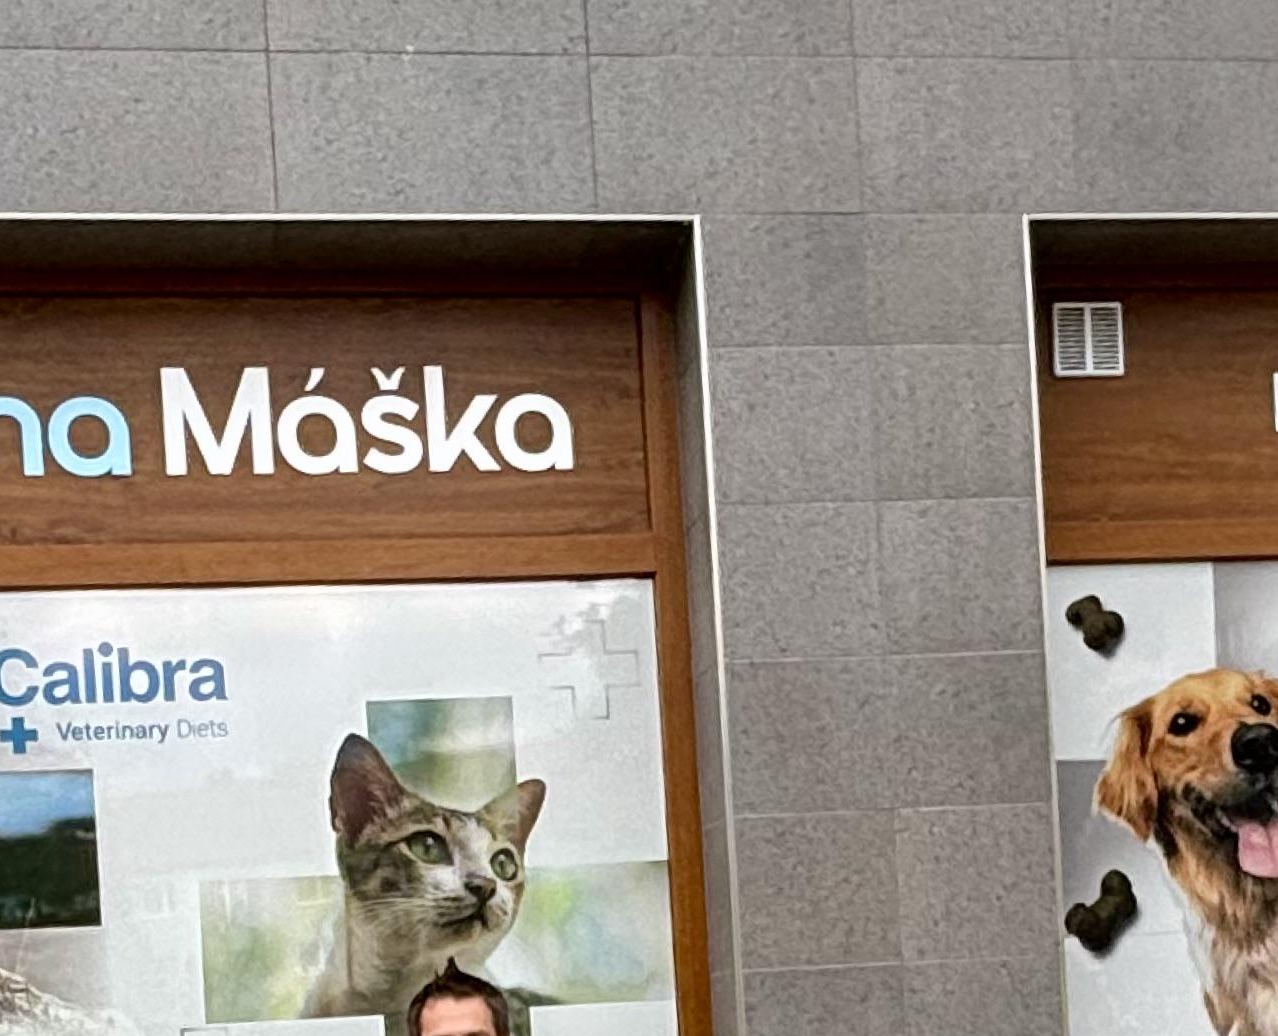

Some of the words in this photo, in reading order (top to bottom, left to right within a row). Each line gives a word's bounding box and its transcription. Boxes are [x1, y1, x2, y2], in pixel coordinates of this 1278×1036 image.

[160, 364, 574, 476] Máška
[56, 720, 169, 743] Veterinary
[176, 718, 228, 739] Diets
